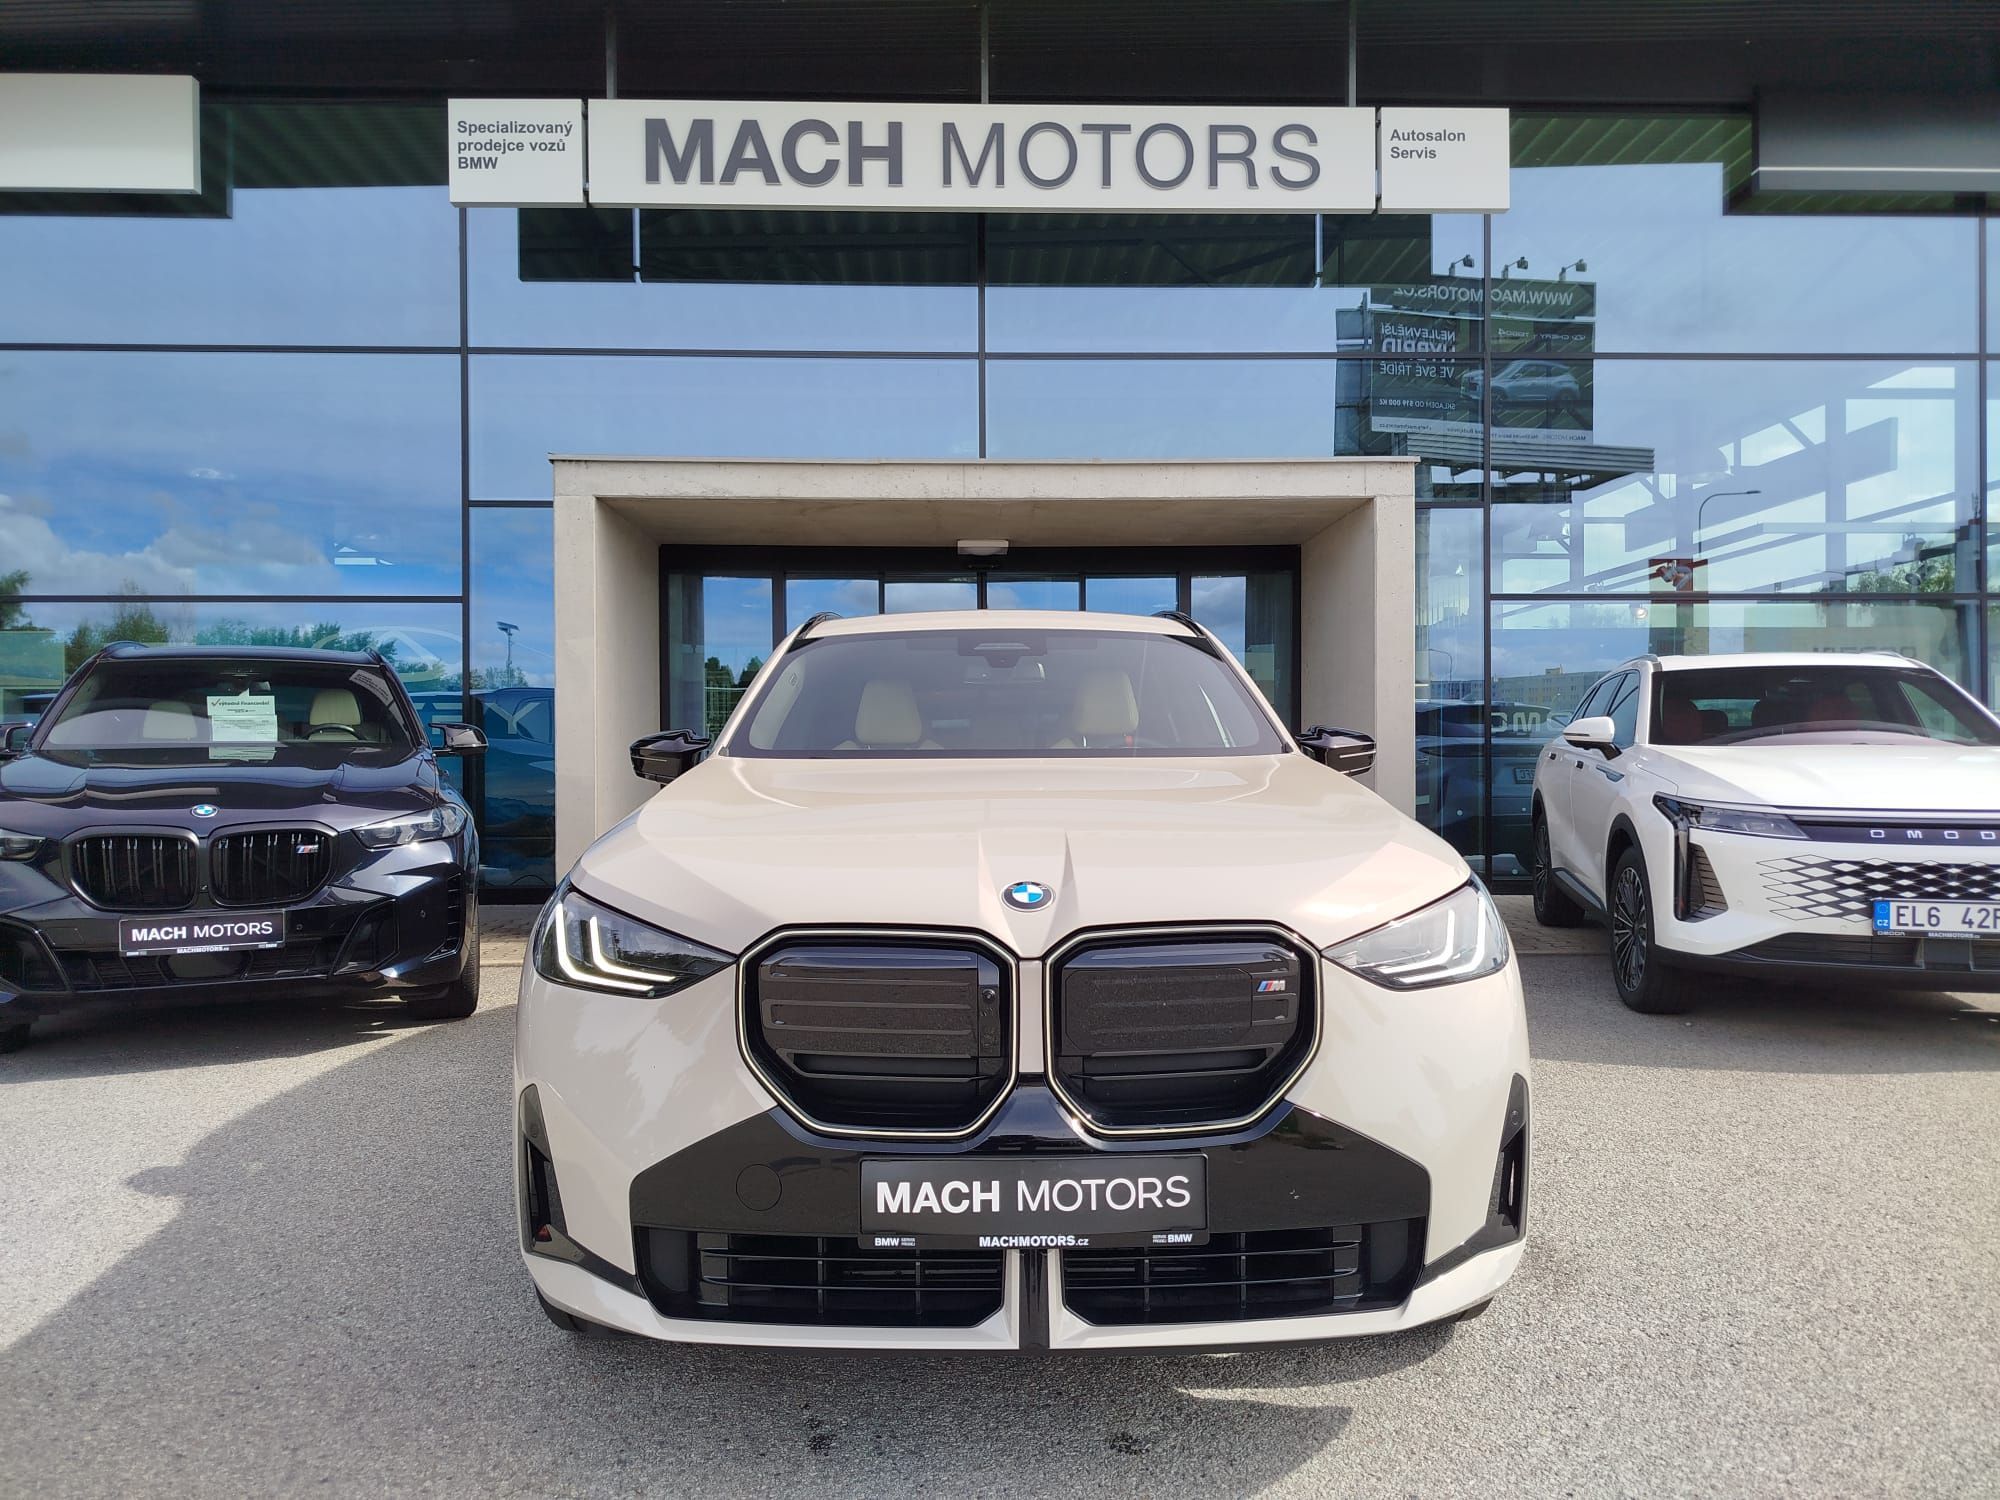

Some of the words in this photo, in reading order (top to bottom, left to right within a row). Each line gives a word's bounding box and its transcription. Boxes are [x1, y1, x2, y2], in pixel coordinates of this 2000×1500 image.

[457, 119, 573, 137] Specializovaný
[1390, 128, 1466, 143] Autosalon
[457, 138, 525, 155] prodejce
[529, 137, 566, 152] vozů
[644, 117, 904, 188] MACH
[941, 120, 1322, 191] MOTORS
[1390, 146, 1437, 160] Servis
[457, 156, 499, 170] BMW
[1896, 905, 1941, 927] EL6
[131, 925, 187, 942] MACH
[193, 921, 273, 939] MOTORS
[876, 1180, 1000, 1215] MACH
[1017, 1175, 1191, 1212] MOTORS
[874, 1237, 900, 1247] BMW
[978, 1235, 1089, 1248] MACHMOTORS.cz
[1167, 1233, 1193, 1243] BMW
